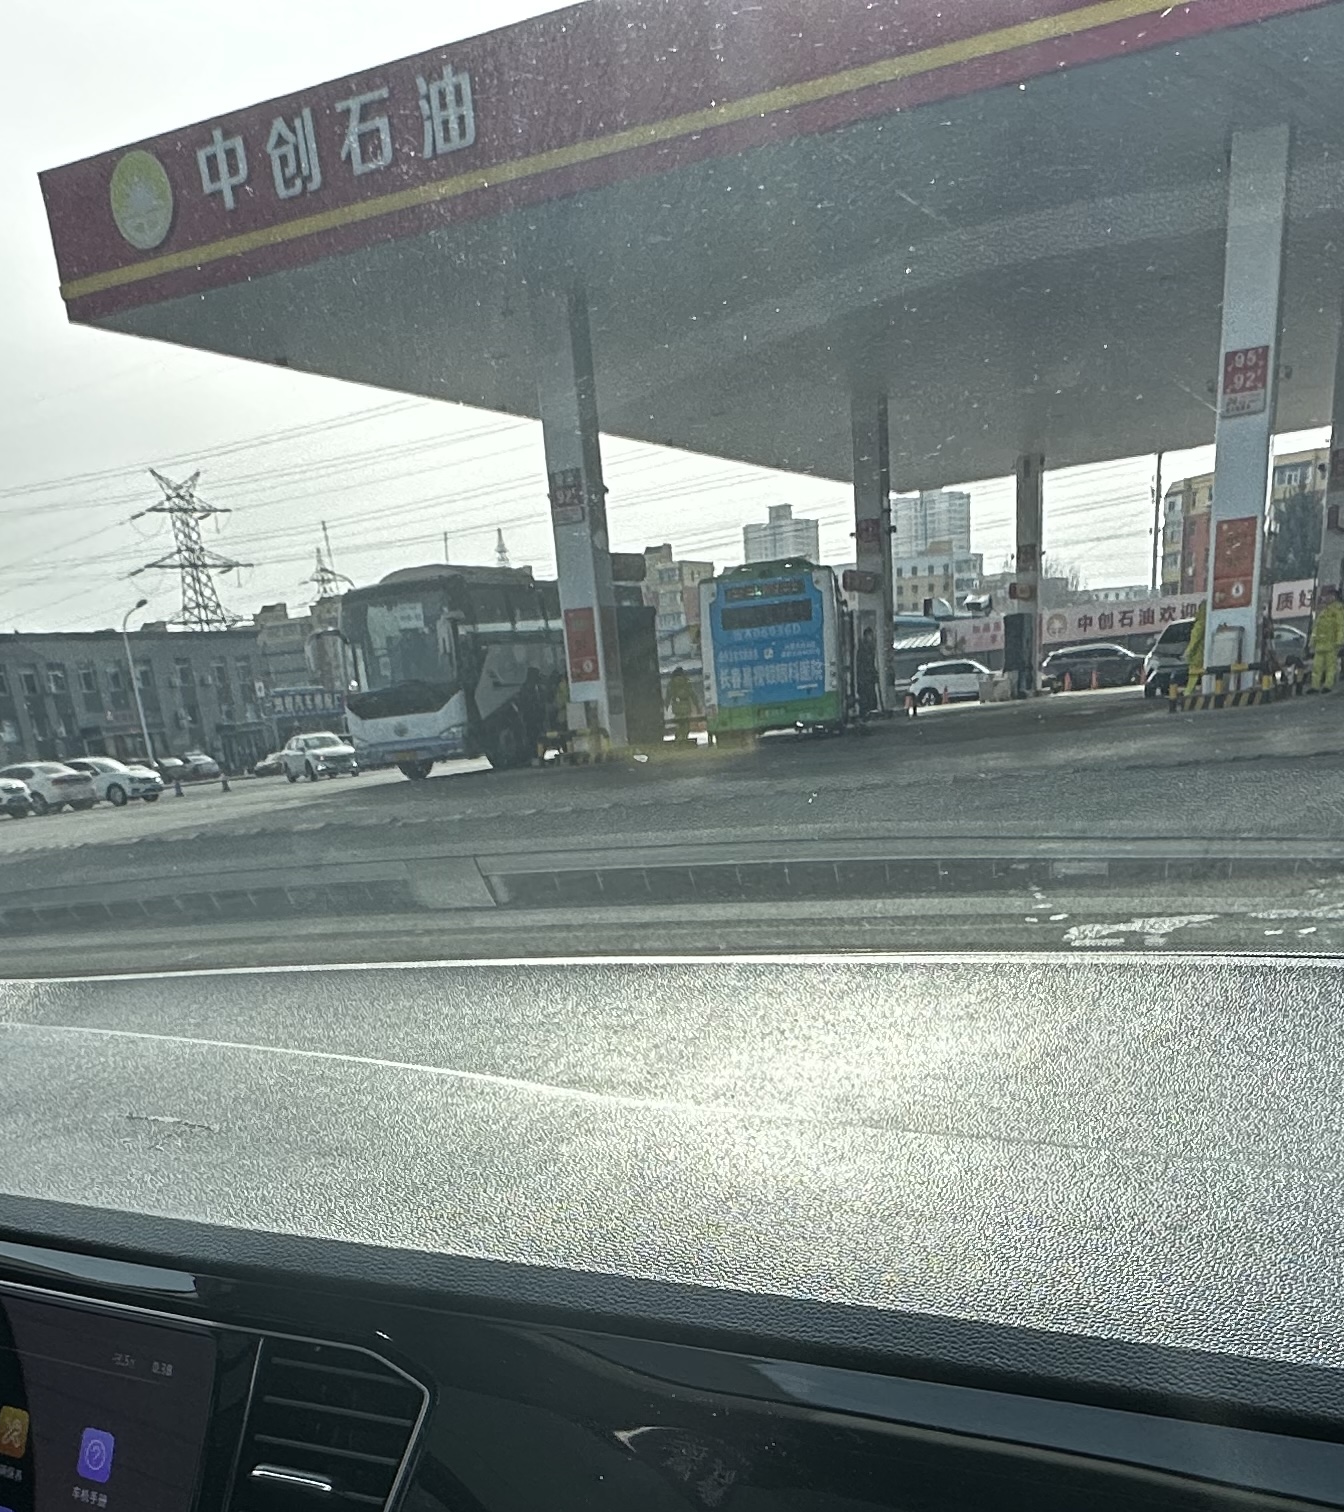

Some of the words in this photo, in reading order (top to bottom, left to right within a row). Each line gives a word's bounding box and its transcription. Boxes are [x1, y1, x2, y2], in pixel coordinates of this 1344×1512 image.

[195, 64, 476, 211] 中创石油
[1077, 602, 1199, 634] 中创石油欢迎
